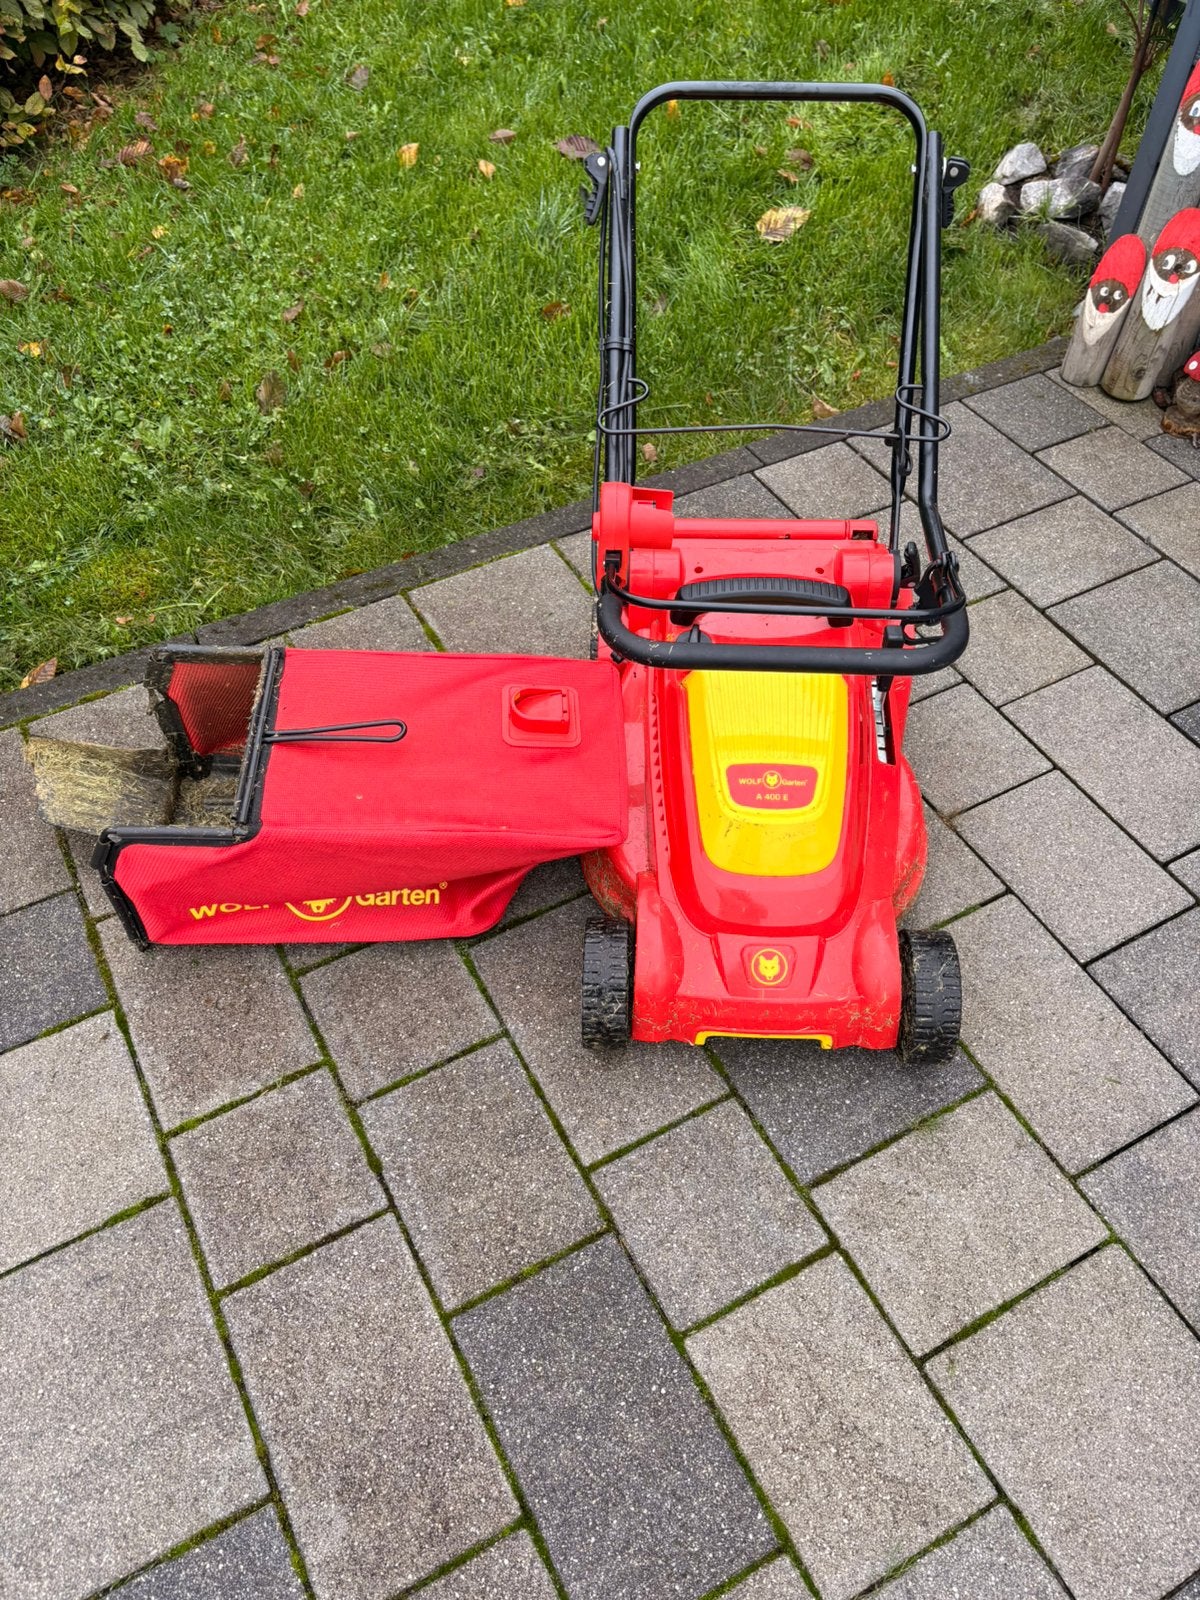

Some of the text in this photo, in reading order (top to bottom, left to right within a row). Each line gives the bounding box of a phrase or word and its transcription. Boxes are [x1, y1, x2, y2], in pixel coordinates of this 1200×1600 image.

[756, 793, 789, 801] A 400 E
[189, 903, 270, 920] WOL
